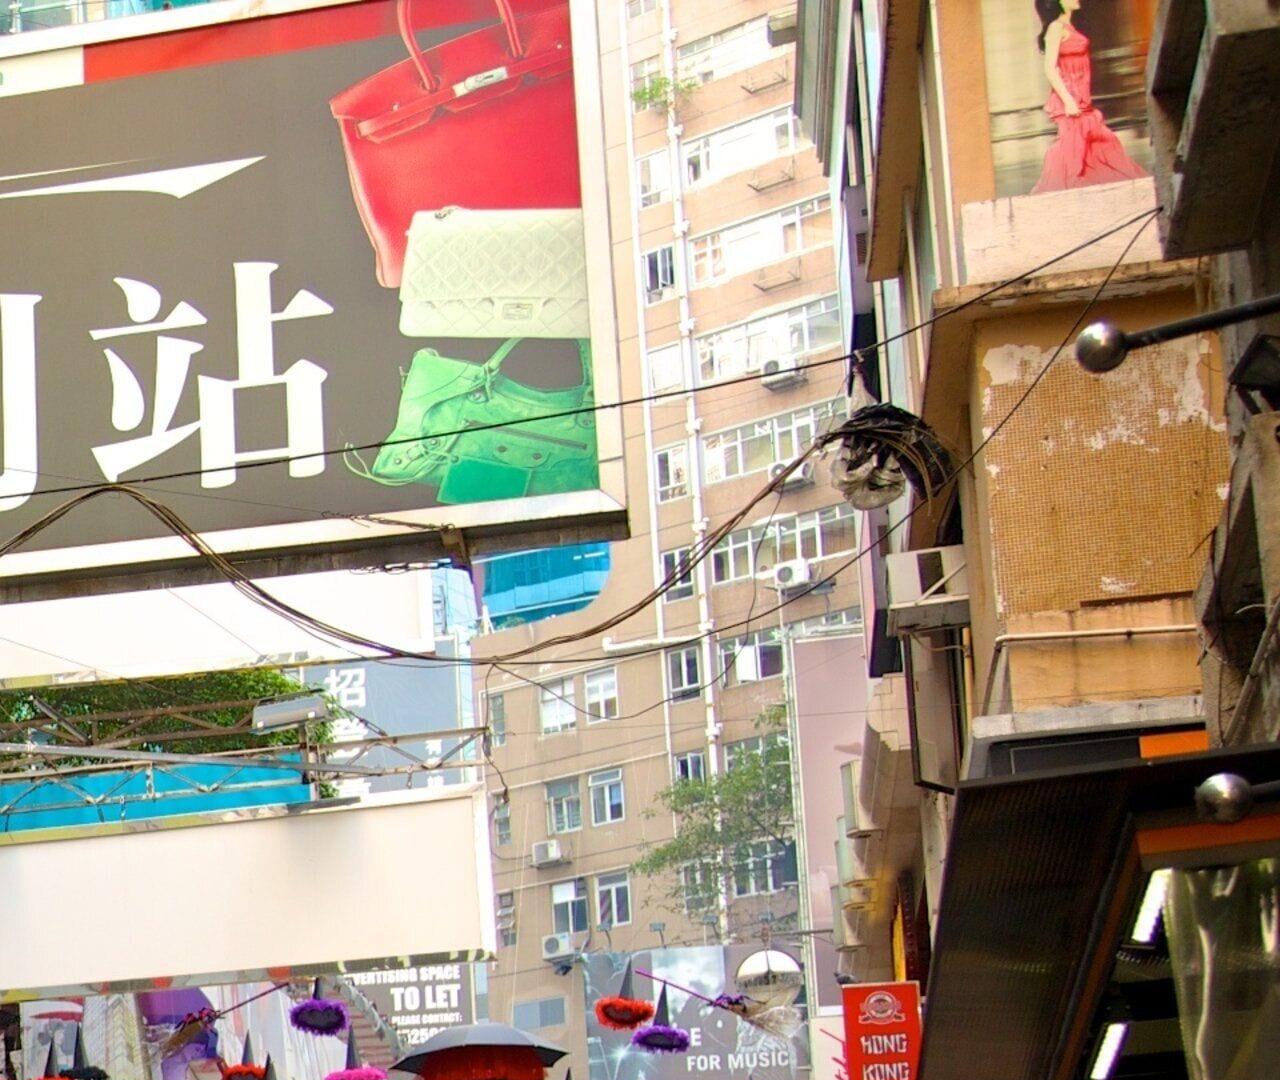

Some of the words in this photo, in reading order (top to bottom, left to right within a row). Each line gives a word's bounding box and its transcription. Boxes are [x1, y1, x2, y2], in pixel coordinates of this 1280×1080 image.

[419, 965, 461, 983] SPACE
[390, 986, 420, 1012] TO
[424, 984, 461, 1010] LET
[392, 1014, 421, 1026] PLEASE
[860, 1033, 908, 1055] HONG
[686, 1054, 721, 1072] FOR
[727, 1051, 790, 1071] MUSIC
